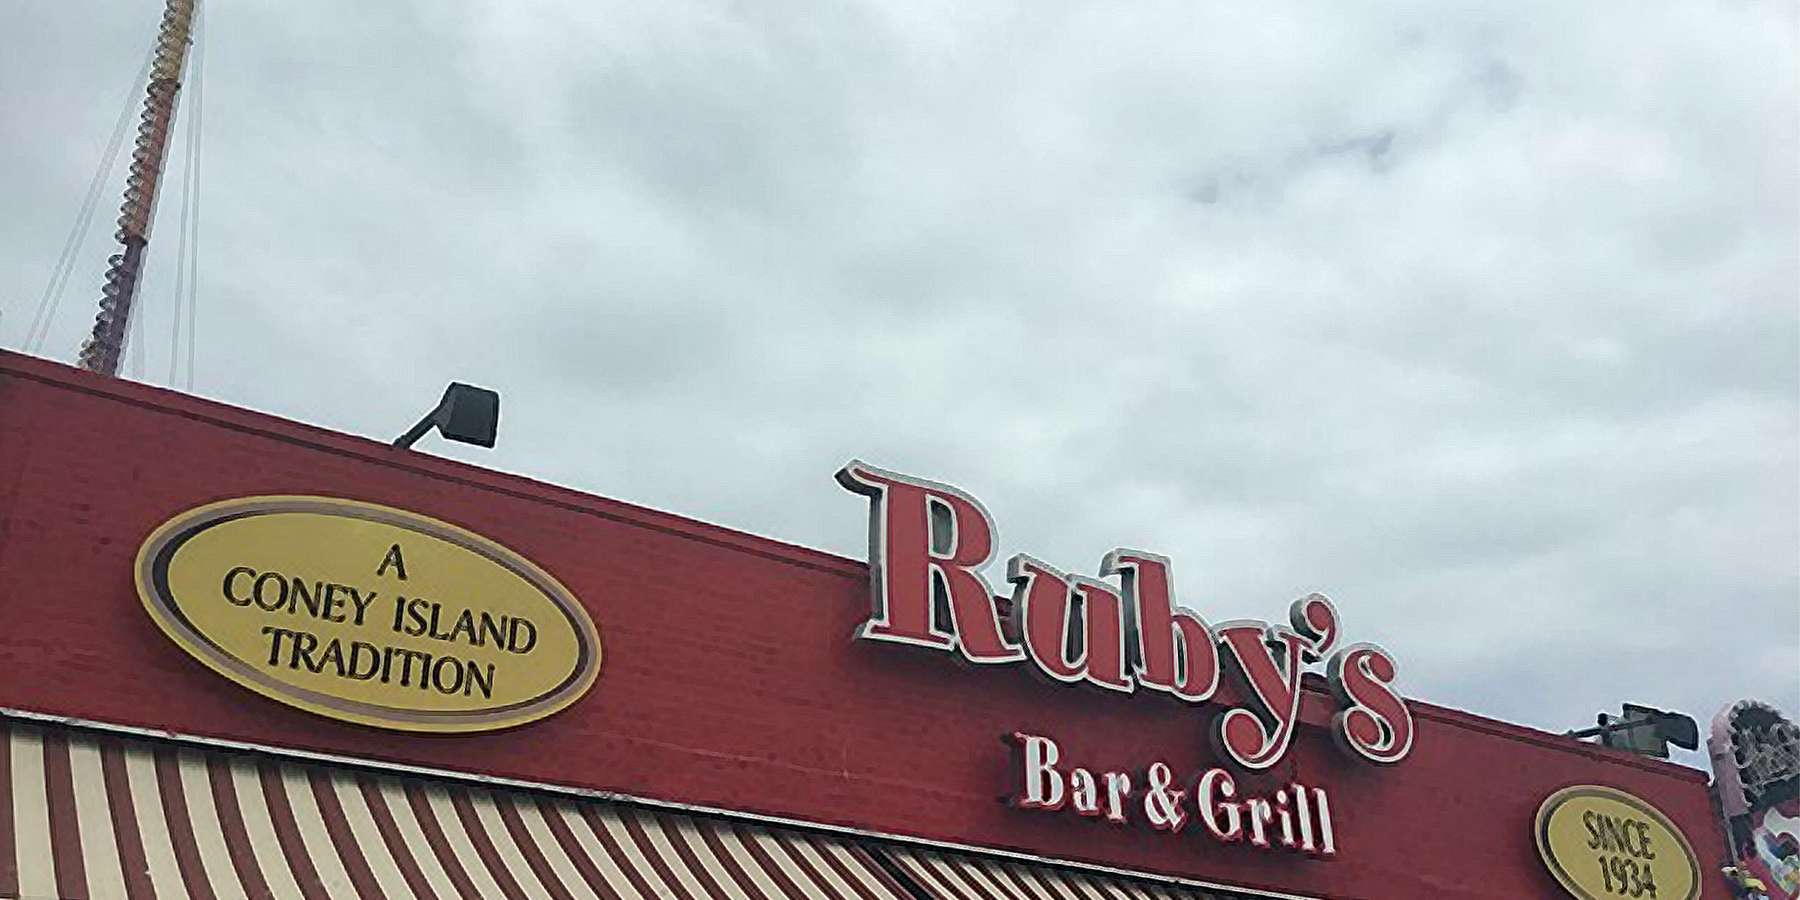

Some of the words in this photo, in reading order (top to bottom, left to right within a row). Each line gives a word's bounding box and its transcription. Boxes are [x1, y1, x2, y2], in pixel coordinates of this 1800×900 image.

[377, 544, 408, 581] A
[222, 566, 377, 626] CONEY
[392, 597, 538, 654] ISLAND
[834, 459, 1415, 769] Ruby's
[262, 626, 496, 699] TRADITION
[1015, 731, 1131, 823] Bar
[1143, 762, 1186, 831] &
[1198, 768, 1337, 855] Grill
[1583, 810, 1656, 860] SINCE
[1598, 856, 1657, 900] 1934
